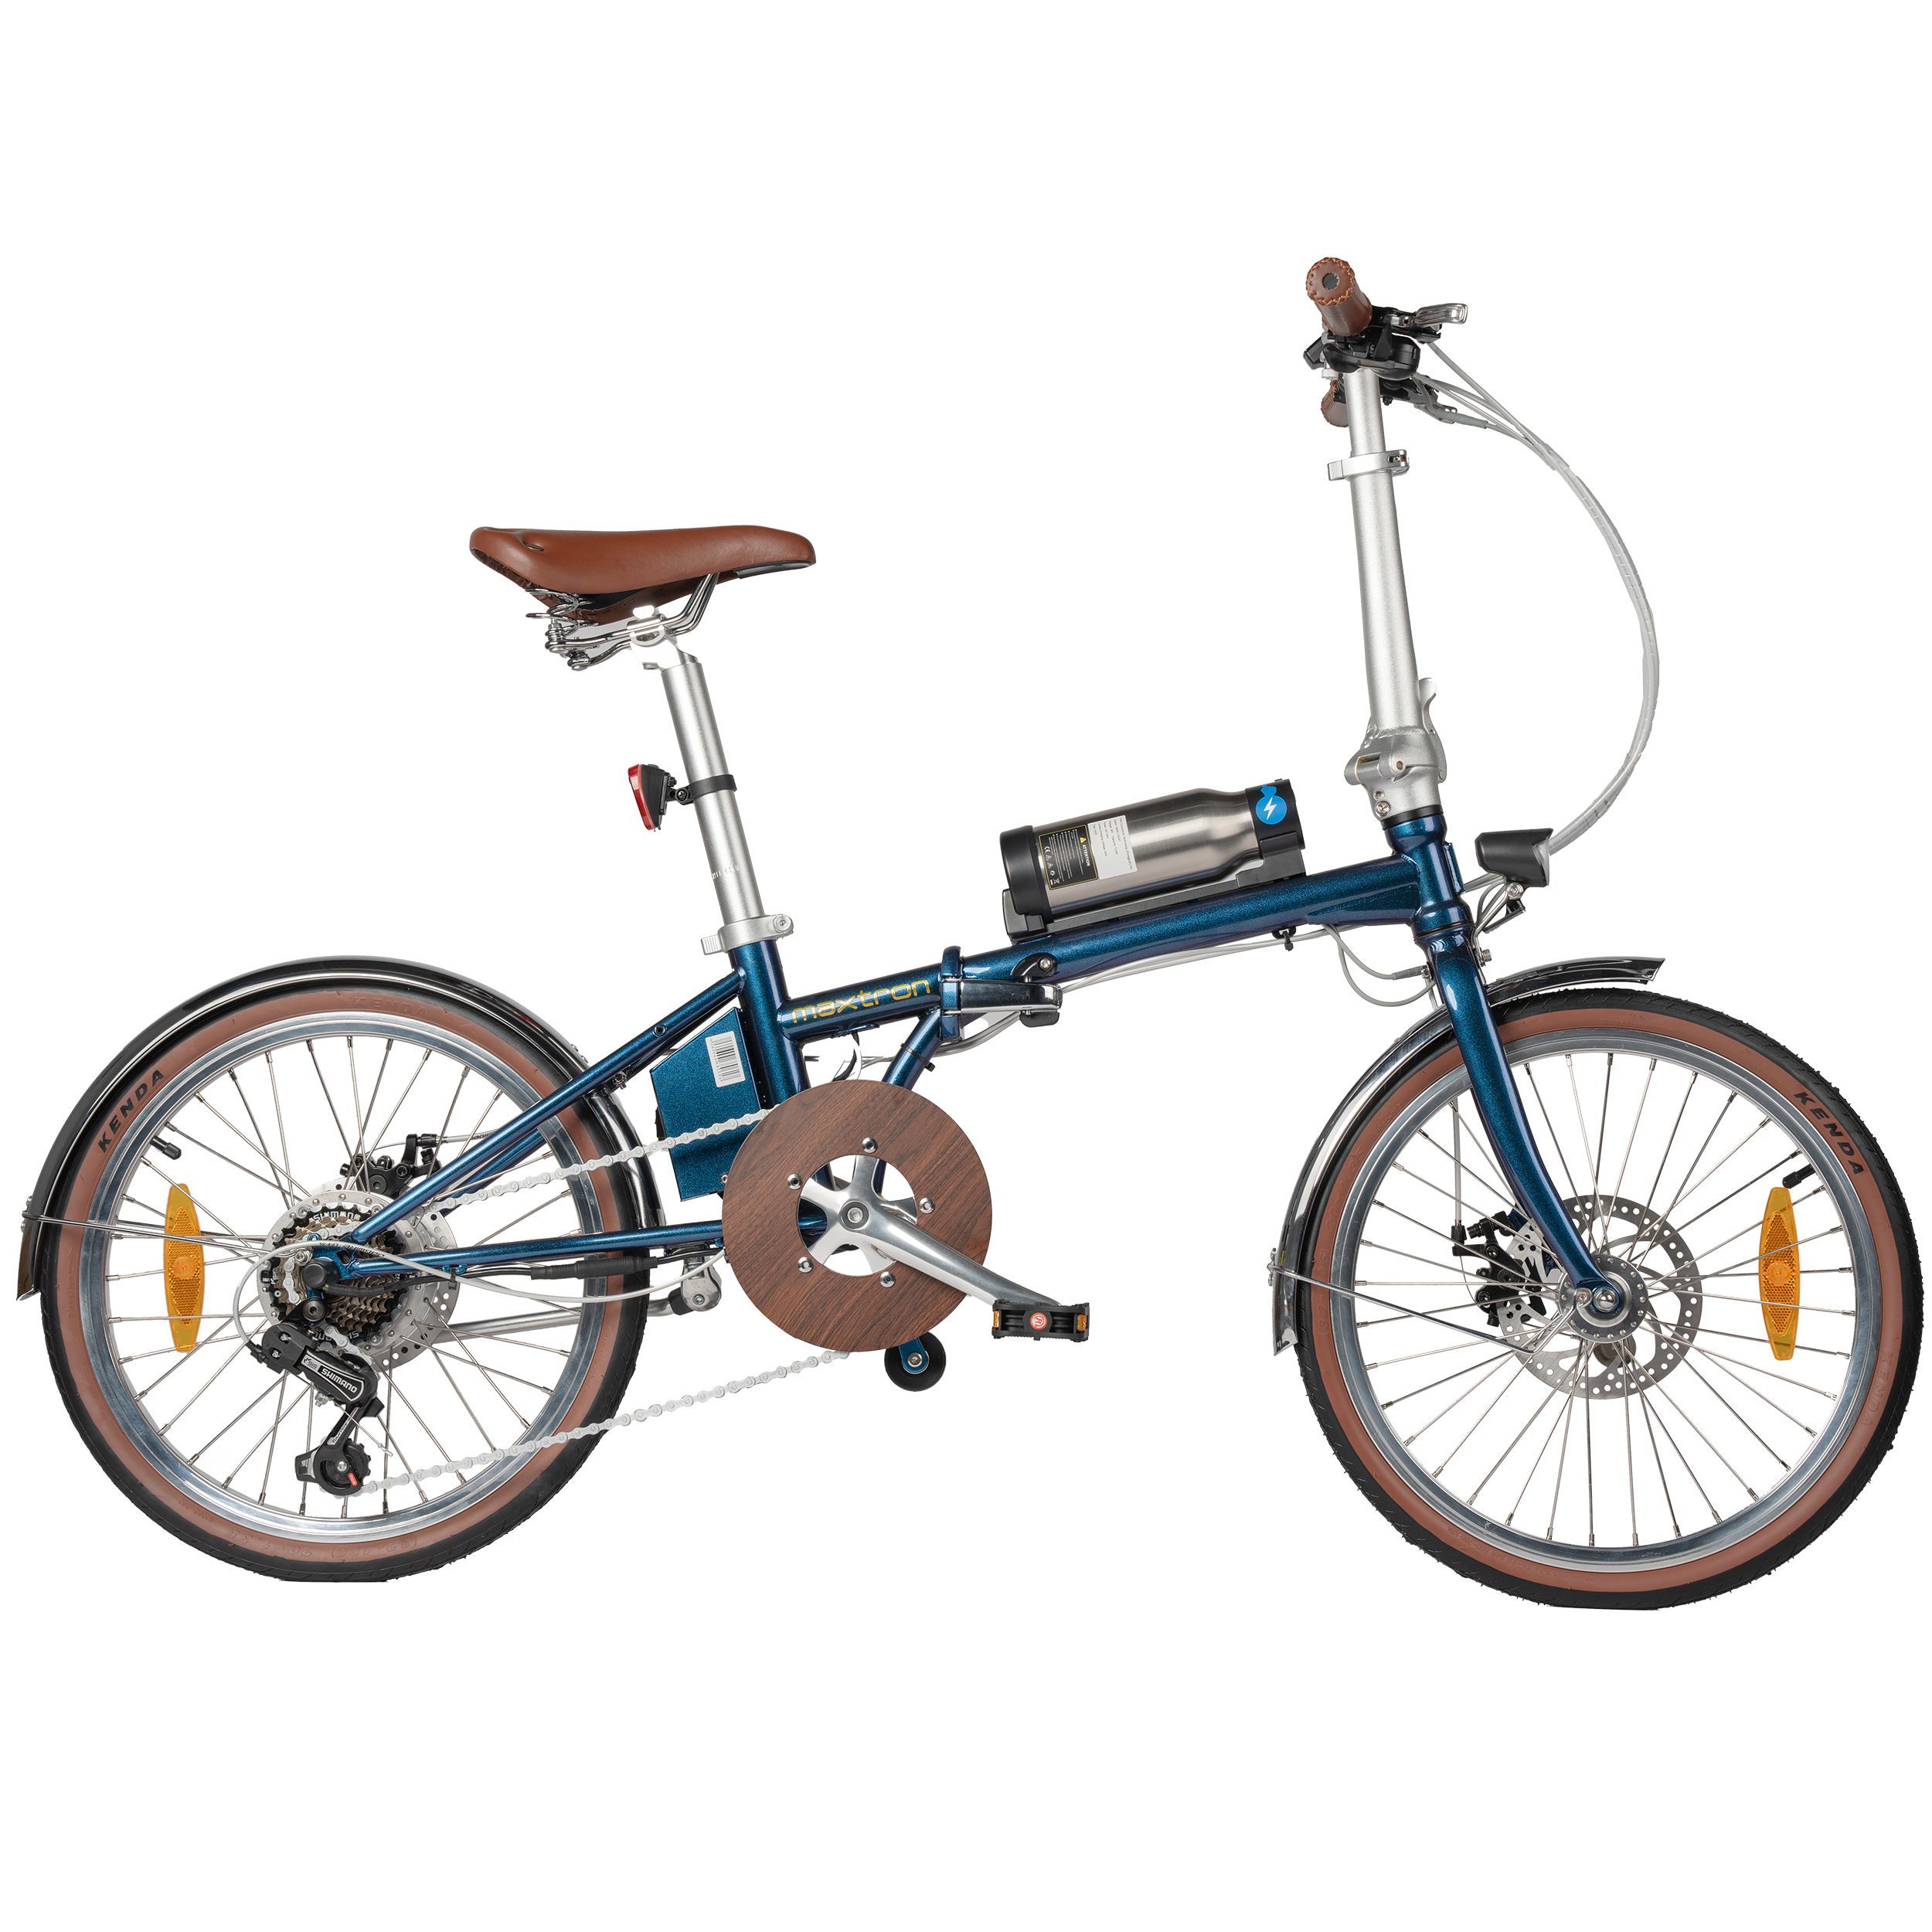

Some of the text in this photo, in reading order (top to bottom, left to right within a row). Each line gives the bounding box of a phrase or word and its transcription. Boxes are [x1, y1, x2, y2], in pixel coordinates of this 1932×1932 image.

[791, 979, 931, 1024] maxtron
[98, 1069, 164, 1152] KENDA
[1794, 1090, 1866, 1177] KENDA
[321, 1368, 358, 1393] SHIMANO
